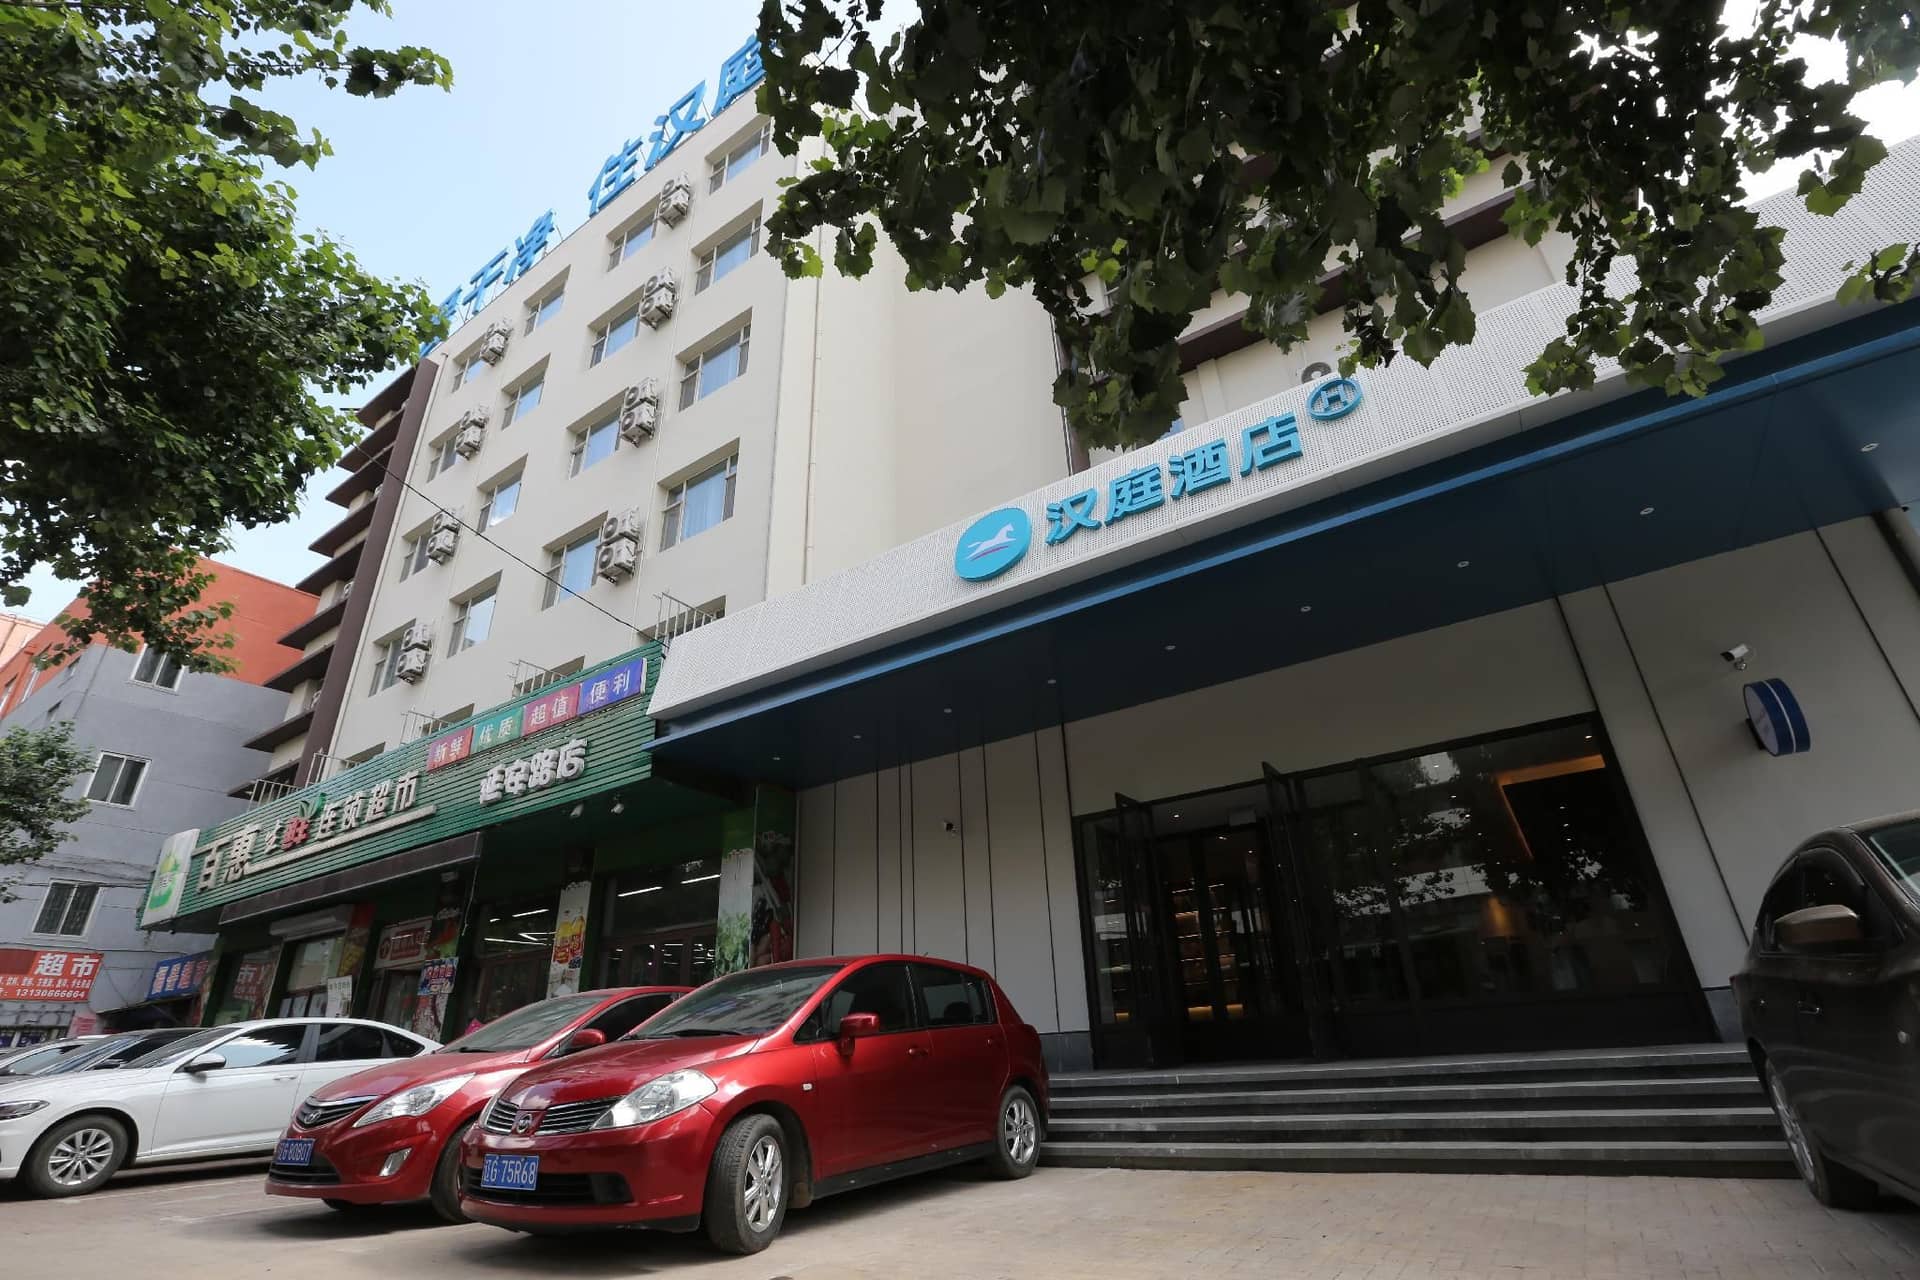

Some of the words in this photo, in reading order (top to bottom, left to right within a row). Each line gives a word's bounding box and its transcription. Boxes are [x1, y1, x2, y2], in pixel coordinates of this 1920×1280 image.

[1045, 411, 1304, 546] 汉庭酒店
[480, 714, 514, 744] 优质
[530, 695, 570, 728] 超值
[590, 669, 631, 706] 便利
[479, 738, 588, 804] 延安路店
[33, 953, 100, 978] 超市
